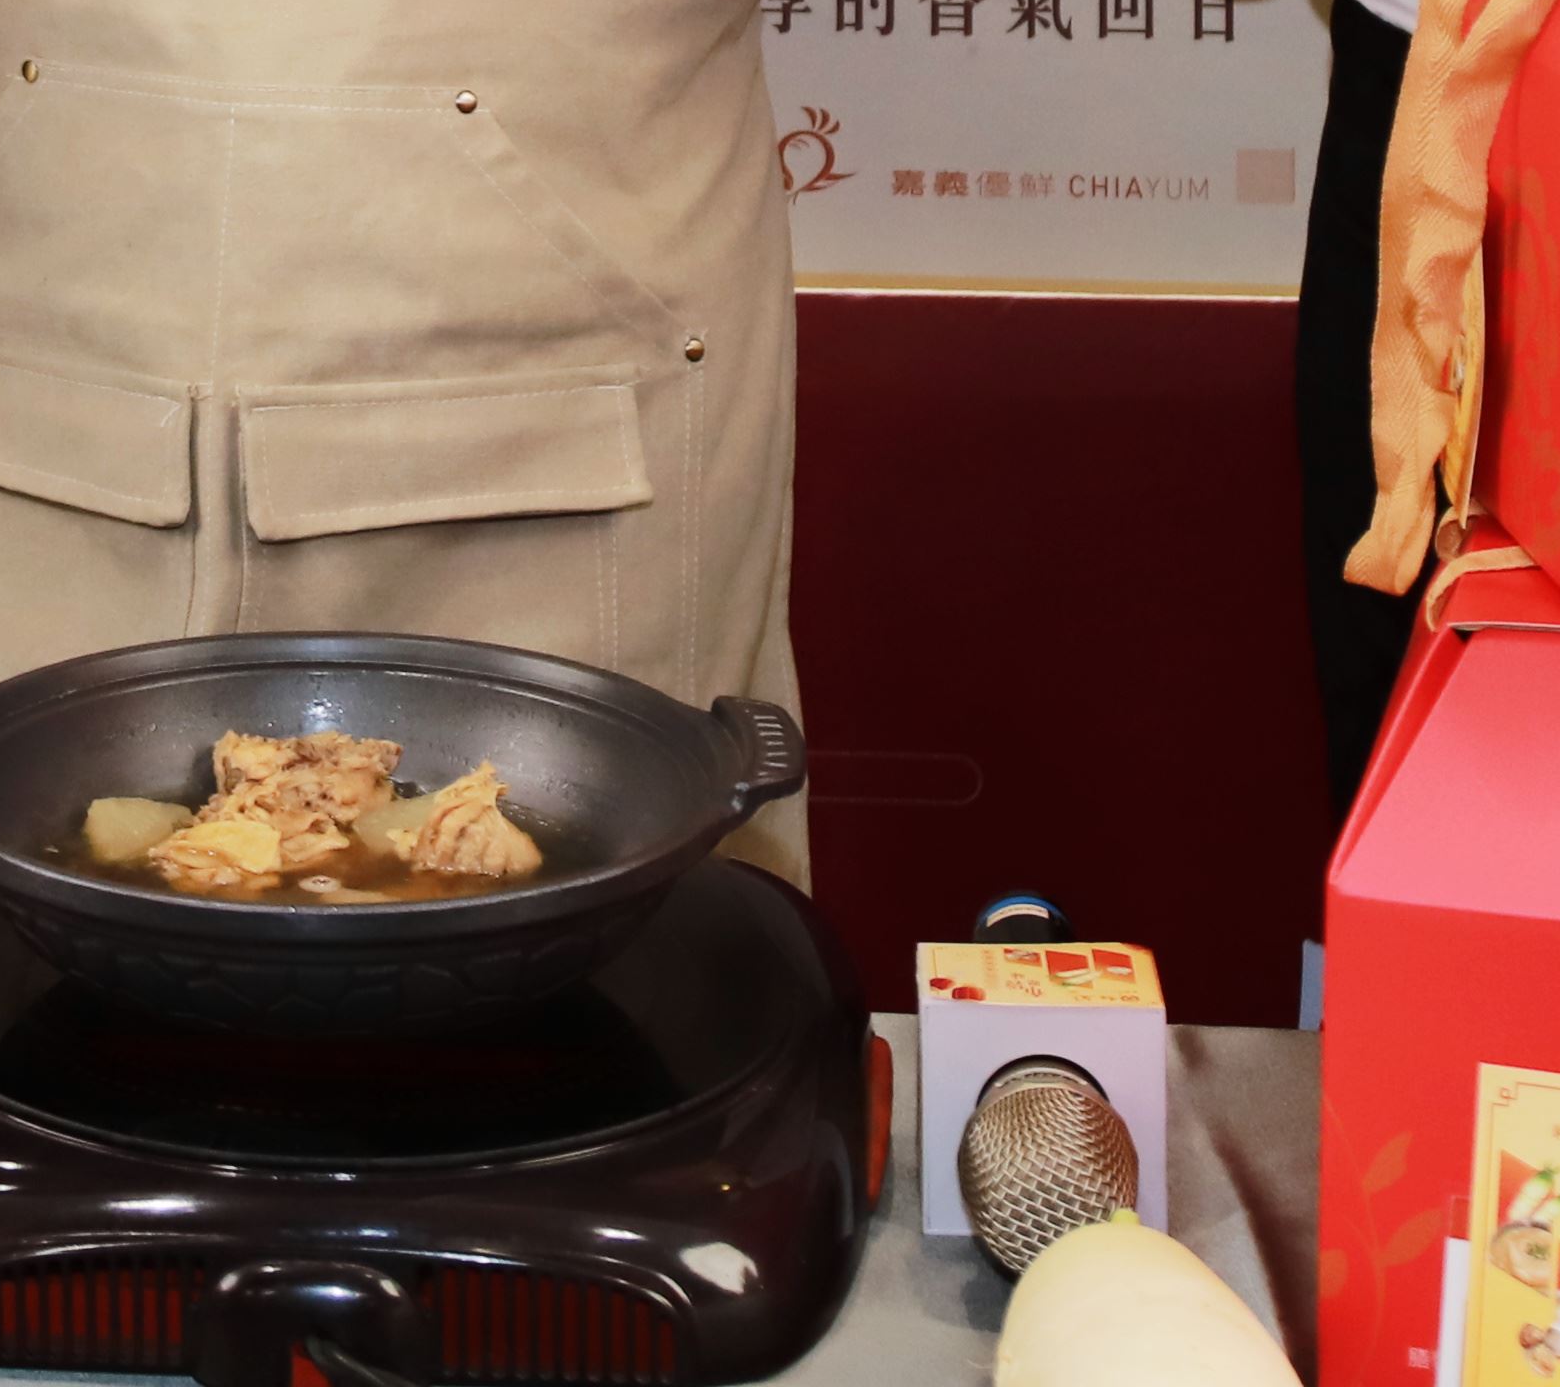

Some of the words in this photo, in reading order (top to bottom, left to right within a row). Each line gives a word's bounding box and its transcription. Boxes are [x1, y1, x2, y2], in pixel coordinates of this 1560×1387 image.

[890, 168, 1054, 200] 嘉義優鮮
[1067, 172, 1211, 201] CHIAYUM
